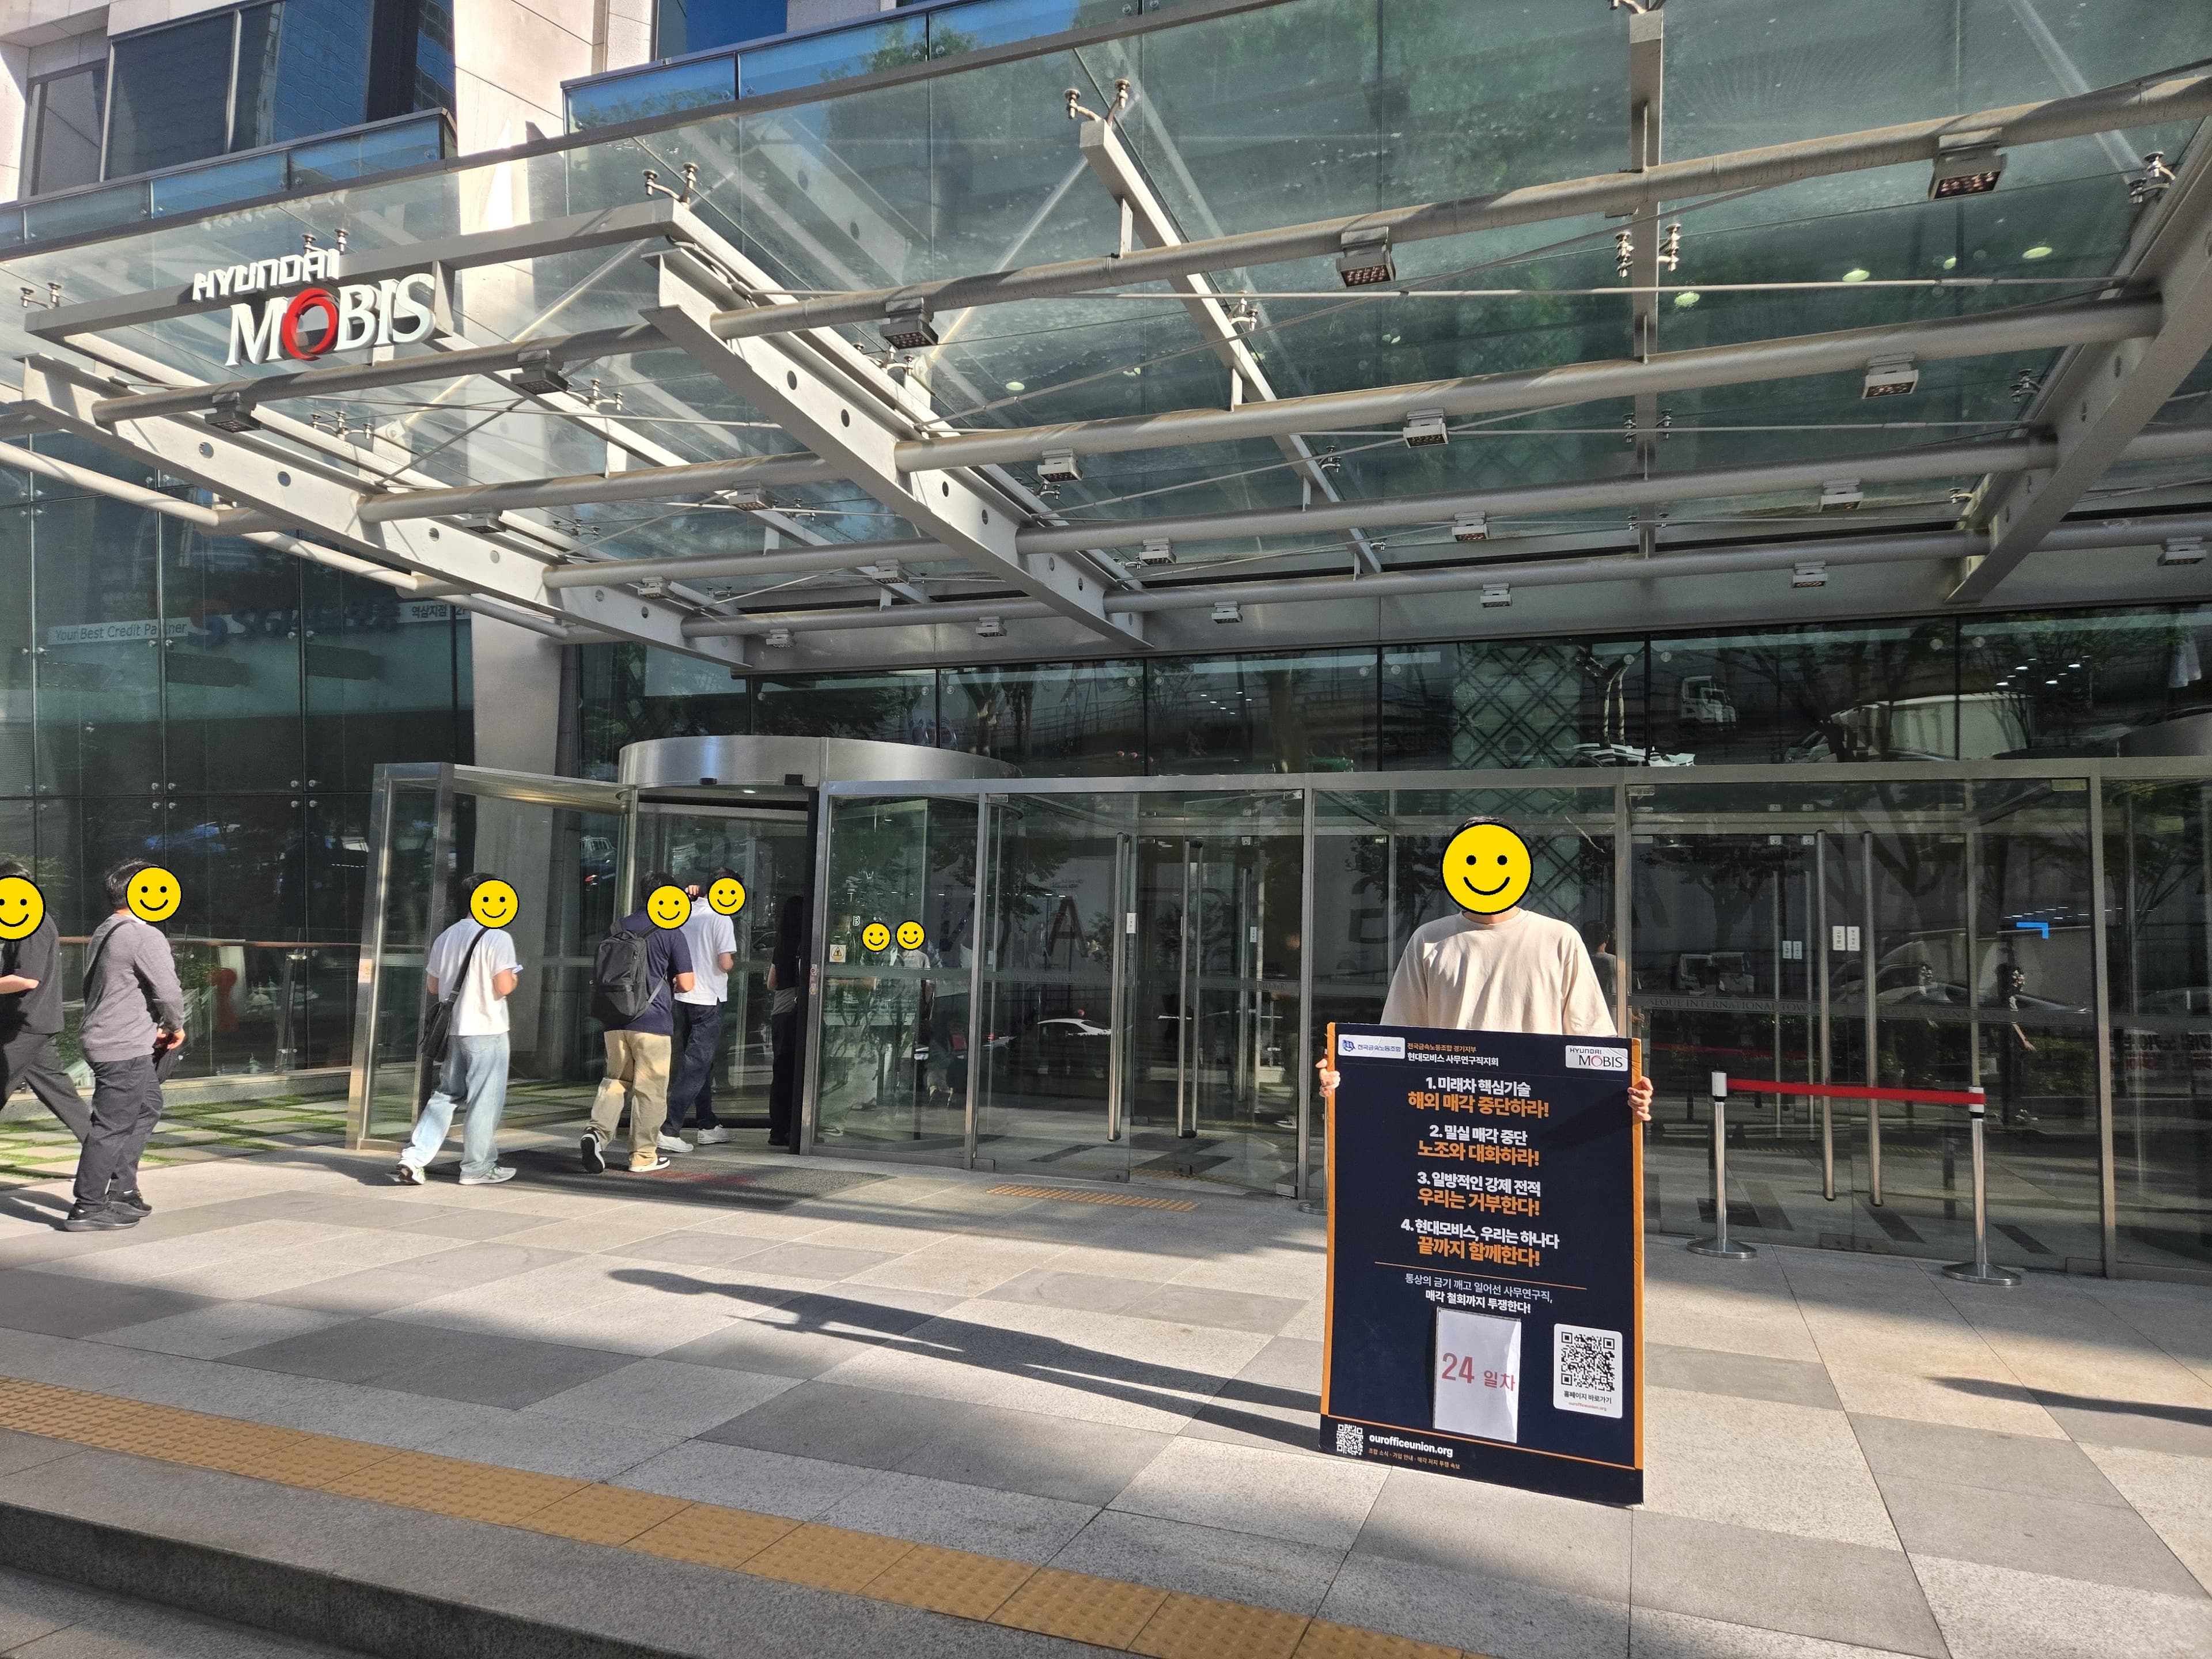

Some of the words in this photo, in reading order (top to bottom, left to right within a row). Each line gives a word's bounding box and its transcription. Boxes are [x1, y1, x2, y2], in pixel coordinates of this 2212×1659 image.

[191, 249, 340, 301] HYUNDAI
[225, 273, 436, 366] MOBIS
[411, 604, 447, 618] 역삼지점
[56, 630, 78, 641] Your
[80, 627, 104, 639] Best
[107, 624, 141, 638] Credit
[145, 623, 187, 635] Paner
[1649, 998, 1683, 1007] SEOUL
[1685, 999, 1776, 1011] INTERNATIONAL
[1781, 1003, 1820, 1012] TOWR
[1357, 1044, 1402, 1053] 전국금속노동조합
[1407, 1042, 1452, 1052] 전국금속노동조합
[1453, 1045, 1477, 1054] 경기지부
[1407, 1052, 1445, 1063] 현대모비스
[1446, 1055, 1499, 1067] 사무연구직지회
[1579, 1055, 1623, 1068] MOBIS
[1426, 1077, 1437, 1089] 1.
[1438, 1076, 1477, 1094] 미래차
[1478, 1078, 1532, 1097] 핵심기술
[1408, 1091, 1440, 1111] 해외
[1442, 1093, 1476, 1113] 매각
[1478, 1096, 1550, 1119] 중단하라!
[1429, 1124, 1443, 1138] 2.
[1444, 1124, 1470, 1142] 밀실
[1472, 1127, 1499, 1144] 매각
[1500, 1129, 1528, 1146] 중단
[1418, 1140, 1466, 1161] 노조와
[1468, 1144, 1540, 1168] 대화하라!
[1417, 1171, 1431, 1185] 3.
[1431, 1171, 1483, 1191] 일방적인
[1484, 1177, 1512, 1194] 강제
[1514, 1179, 1541, 1197] 전적
[1417, 1187, 1467, 1210] 우리는
[1468, 1193, 1540, 1217] 거부한다!
[1400, 1218, 1414, 1232] 4.
[1415, 1218, 1479, 1241] 현대모비스,
[1480, 1226, 1519, 1244] 우리는
[1520, 1230, 1560, 1249] 하나다
[1418, 1236, 1465, 1259] 끝까지
[1468, 1241, 1540, 1267] 함께한다!
[1405, 1273, 1431, 1286] 통상의
[1434, 1277, 1452, 1289] 금기
[1453, 1279, 1472, 1291] 깨고
[1474, 1281, 1501, 1295] 일어선
[1503, 1286, 1553, 1304] 사무연구직,
[1425, 1289, 1445, 1302] 매각
[1446, 1291, 1485, 1309] 철회까지
[1487, 1298, 1532, 1314] 투쟁한다!
[1442, 1352, 1475, 1384] 24
[1483, 1370, 1516, 1391] 일차
[1563, 1391, 1587, 1400] 홈페이지
[1588, 1394, 1612, 1404] 바로가기
[1369, 1434, 1453, 1458] ourofficeunion.org
